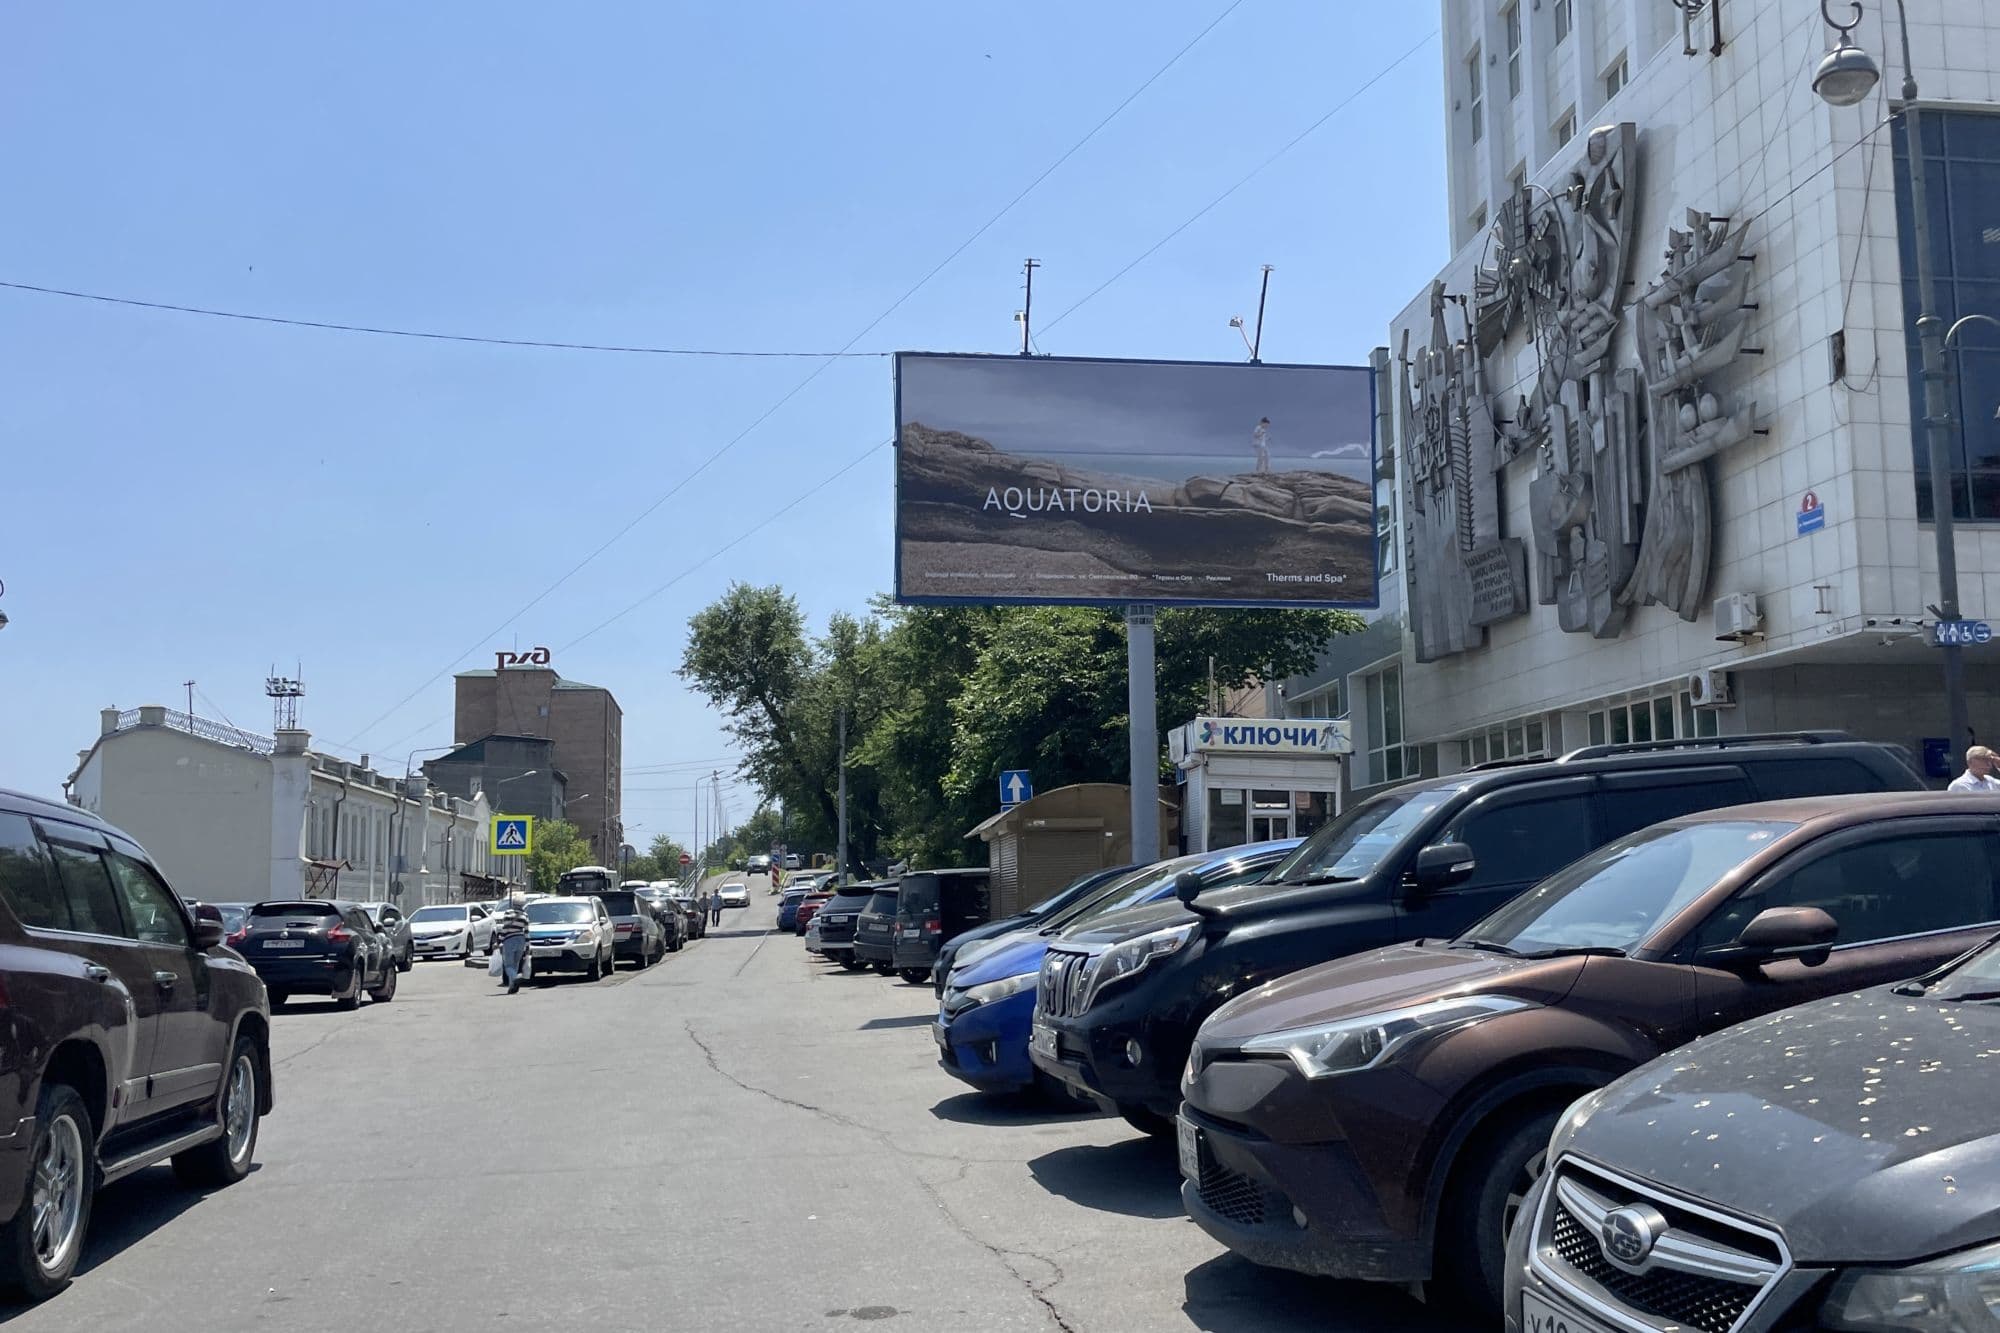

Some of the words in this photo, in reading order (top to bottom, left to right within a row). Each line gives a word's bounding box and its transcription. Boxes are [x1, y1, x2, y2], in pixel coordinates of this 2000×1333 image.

[982, 485, 1154, 519] AQUATORIA
[1806, 494, 1813, 510] 2
[1265, 572, 1303, 583] Therms
[1304, 573, 1323, 583] and
[1223, 726, 1318, 747] КЛЮЧИ
